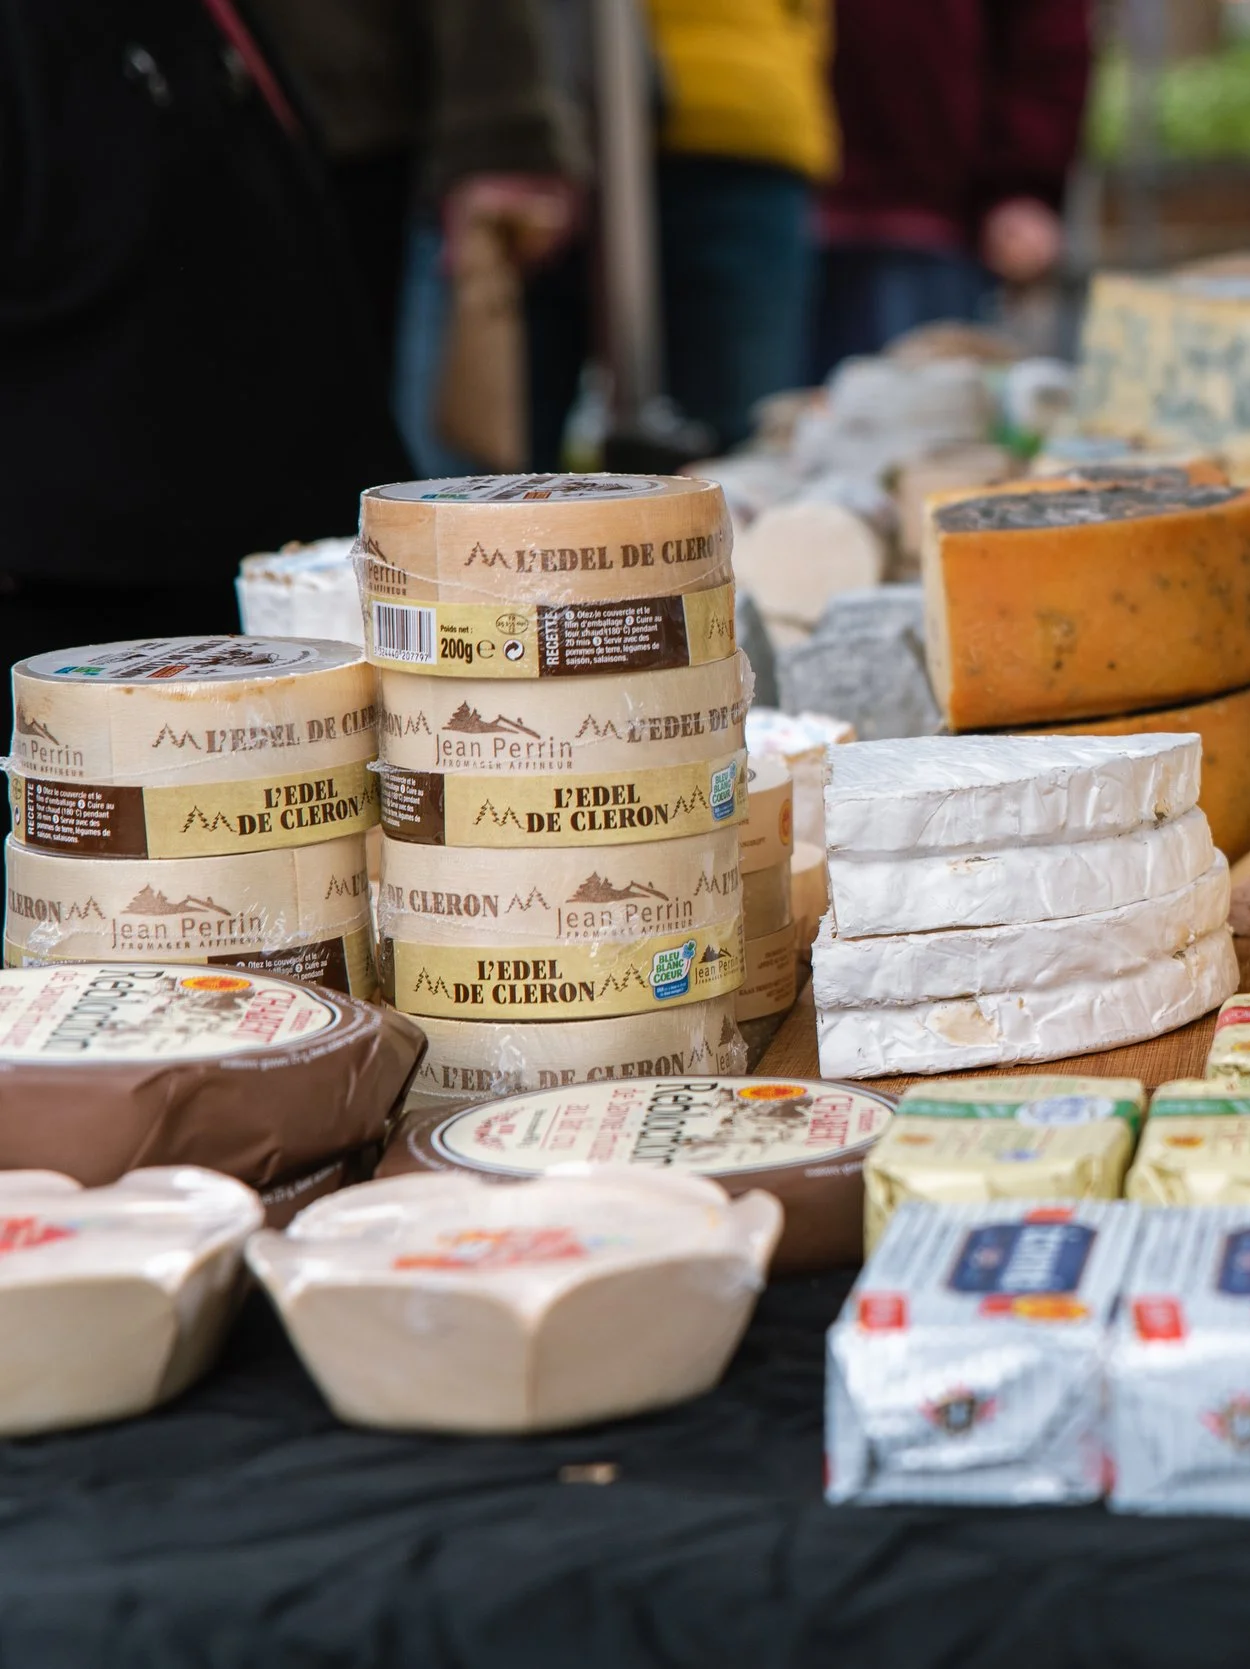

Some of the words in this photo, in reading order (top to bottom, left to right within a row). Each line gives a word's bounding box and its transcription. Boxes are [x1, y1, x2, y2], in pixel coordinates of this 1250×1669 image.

[515, 546, 613, 573] L'EDEL
[620, 543, 655, 569] DE
[661, 533, 716, 565] CLERO
[603, 608, 635, 618] couvercle
[636, 615, 653, 624] Cuire
[440, 624, 457, 633] Poids
[632, 623, 658, 634] pendant
[638, 634, 650, 642] des
[545, 612, 559, 666] RECETTE
[440, 638, 473, 664] 200g
[565, 648, 595, 658] pommes
[651, 642, 660, 650] de
[709, 706, 729, 732] DE
[206, 723, 300, 754] L'EDEL
[307, 717, 337, 743] DE
[342, 705, 376, 736] CLER
[31, 739, 84, 767] Perrin
[436, 733, 481, 766] Jean
[493, 736, 573, 759] Perrin
[510, 760, 573, 770] AFFINEUR
[60, 790, 87, 800] couvercle
[263, 778, 338, 809] L'EDEL
[553, 784, 641, 809] L'EDEL
[83, 811, 110, 819] pendant
[87, 801, 105, 810] Cuire
[237, 812, 272, 836] DE
[280, 795, 359, 830] CLERON
[89, 819, 101, 827] des
[526, 812, 562, 833] DE
[570, 804, 669, 831] CLERON
[75, 826, 101, 837] légumes
[387, 883, 404, 909] DE
[409, 889, 499, 918] CLERON
[556, 907, 612, 939] Jean
[625, 898, 693, 927] Perrin
[112, 918, 168, 948] Jean
[181, 912, 262, 938] Perrin
[121, 941, 190, 950] FROMAGER
[656, 959, 684, 973] BLANC
[659, 951, 680, 963] BLEU
[477, 960, 563, 981] L'EDEL
[653, 968, 683, 984] COEUR
[694, 965, 716, 985] Jean
[453, 983, 484, 1004] DE
[492, 981, 595, 1004] CLERON
[538, 1069, 576, 1089] DE
[587, 1052, 685, 1083] CLERON
